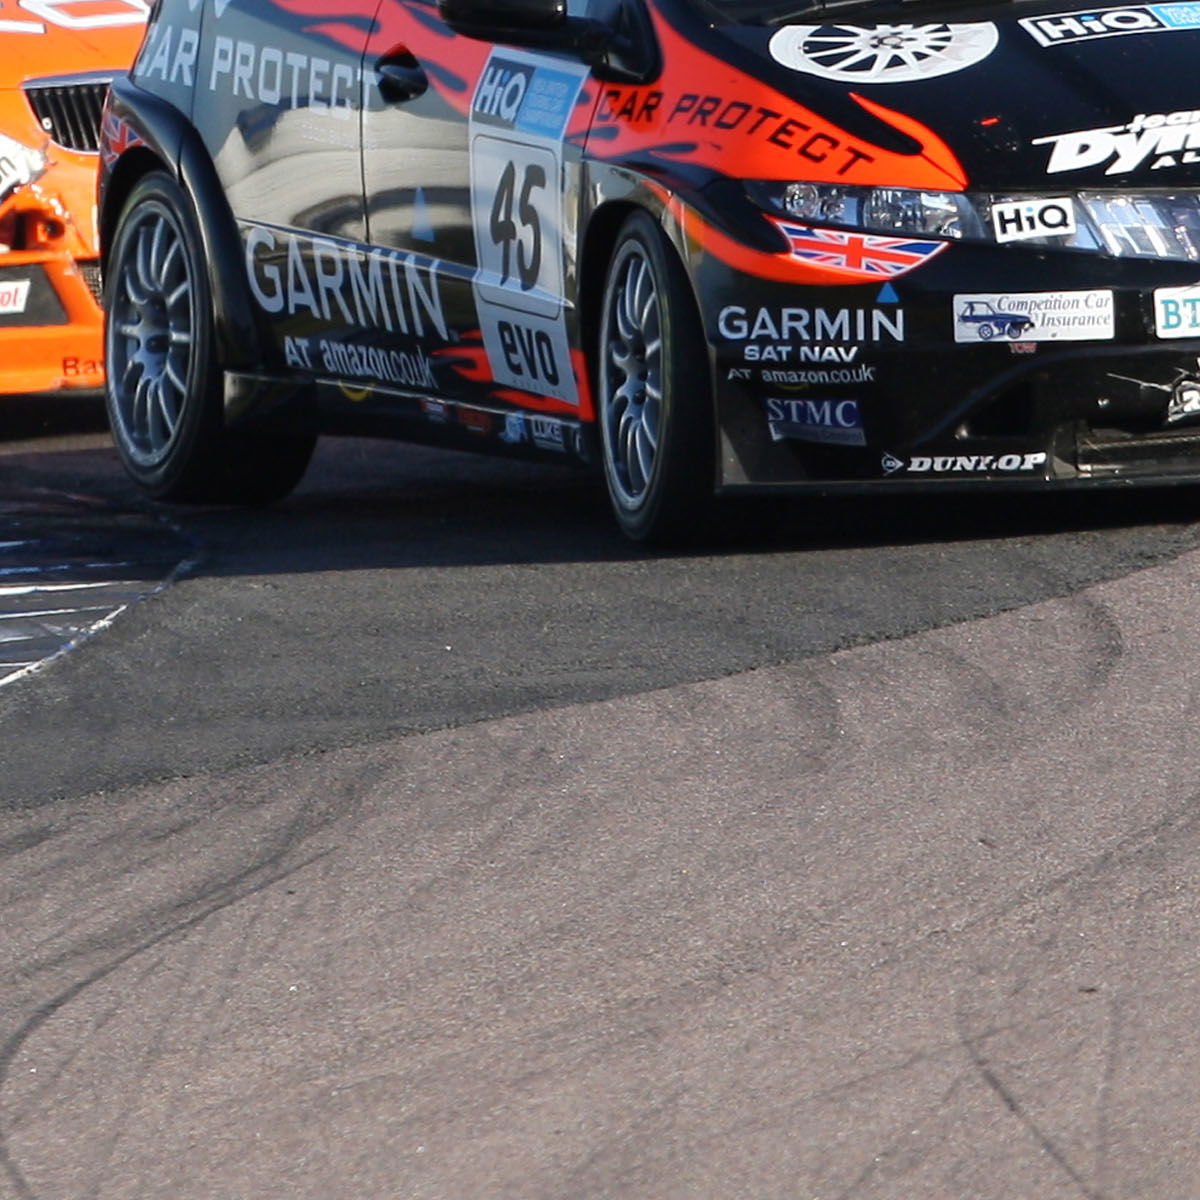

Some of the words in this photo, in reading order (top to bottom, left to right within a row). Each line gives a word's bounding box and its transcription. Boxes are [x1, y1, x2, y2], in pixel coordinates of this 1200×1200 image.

[1037, 10, 1159, 39] HiQ
[209, 35, 379, 123] PROTECT
[474, 66, 527, 122] HiQ
[596, 90, 664, 122] CAR
[667, 93, 875, 176] PROTECT
[490, 160, 546, 292] 45
[997, 204, 1071, 235] HiQ
[246, 227, 449, 341] GARMIN
[997, 293, 1082, 315] Competition
[1083, 292, 1111, 311] Car
[1039, 312, 1111, 328] Insurance
[718, 305, 905, 342] GARMIN
[284, 335, 312, 368] AT
[498, 320, 560, 386] evo
[743, 345, 792, 361] SAT
[800, 345, 859, 362] NAV
[727, 368, 753, 381] AT
[761, 364, 876, 384] amazon.co.uk
[767, 398, 858, 428] STMC
